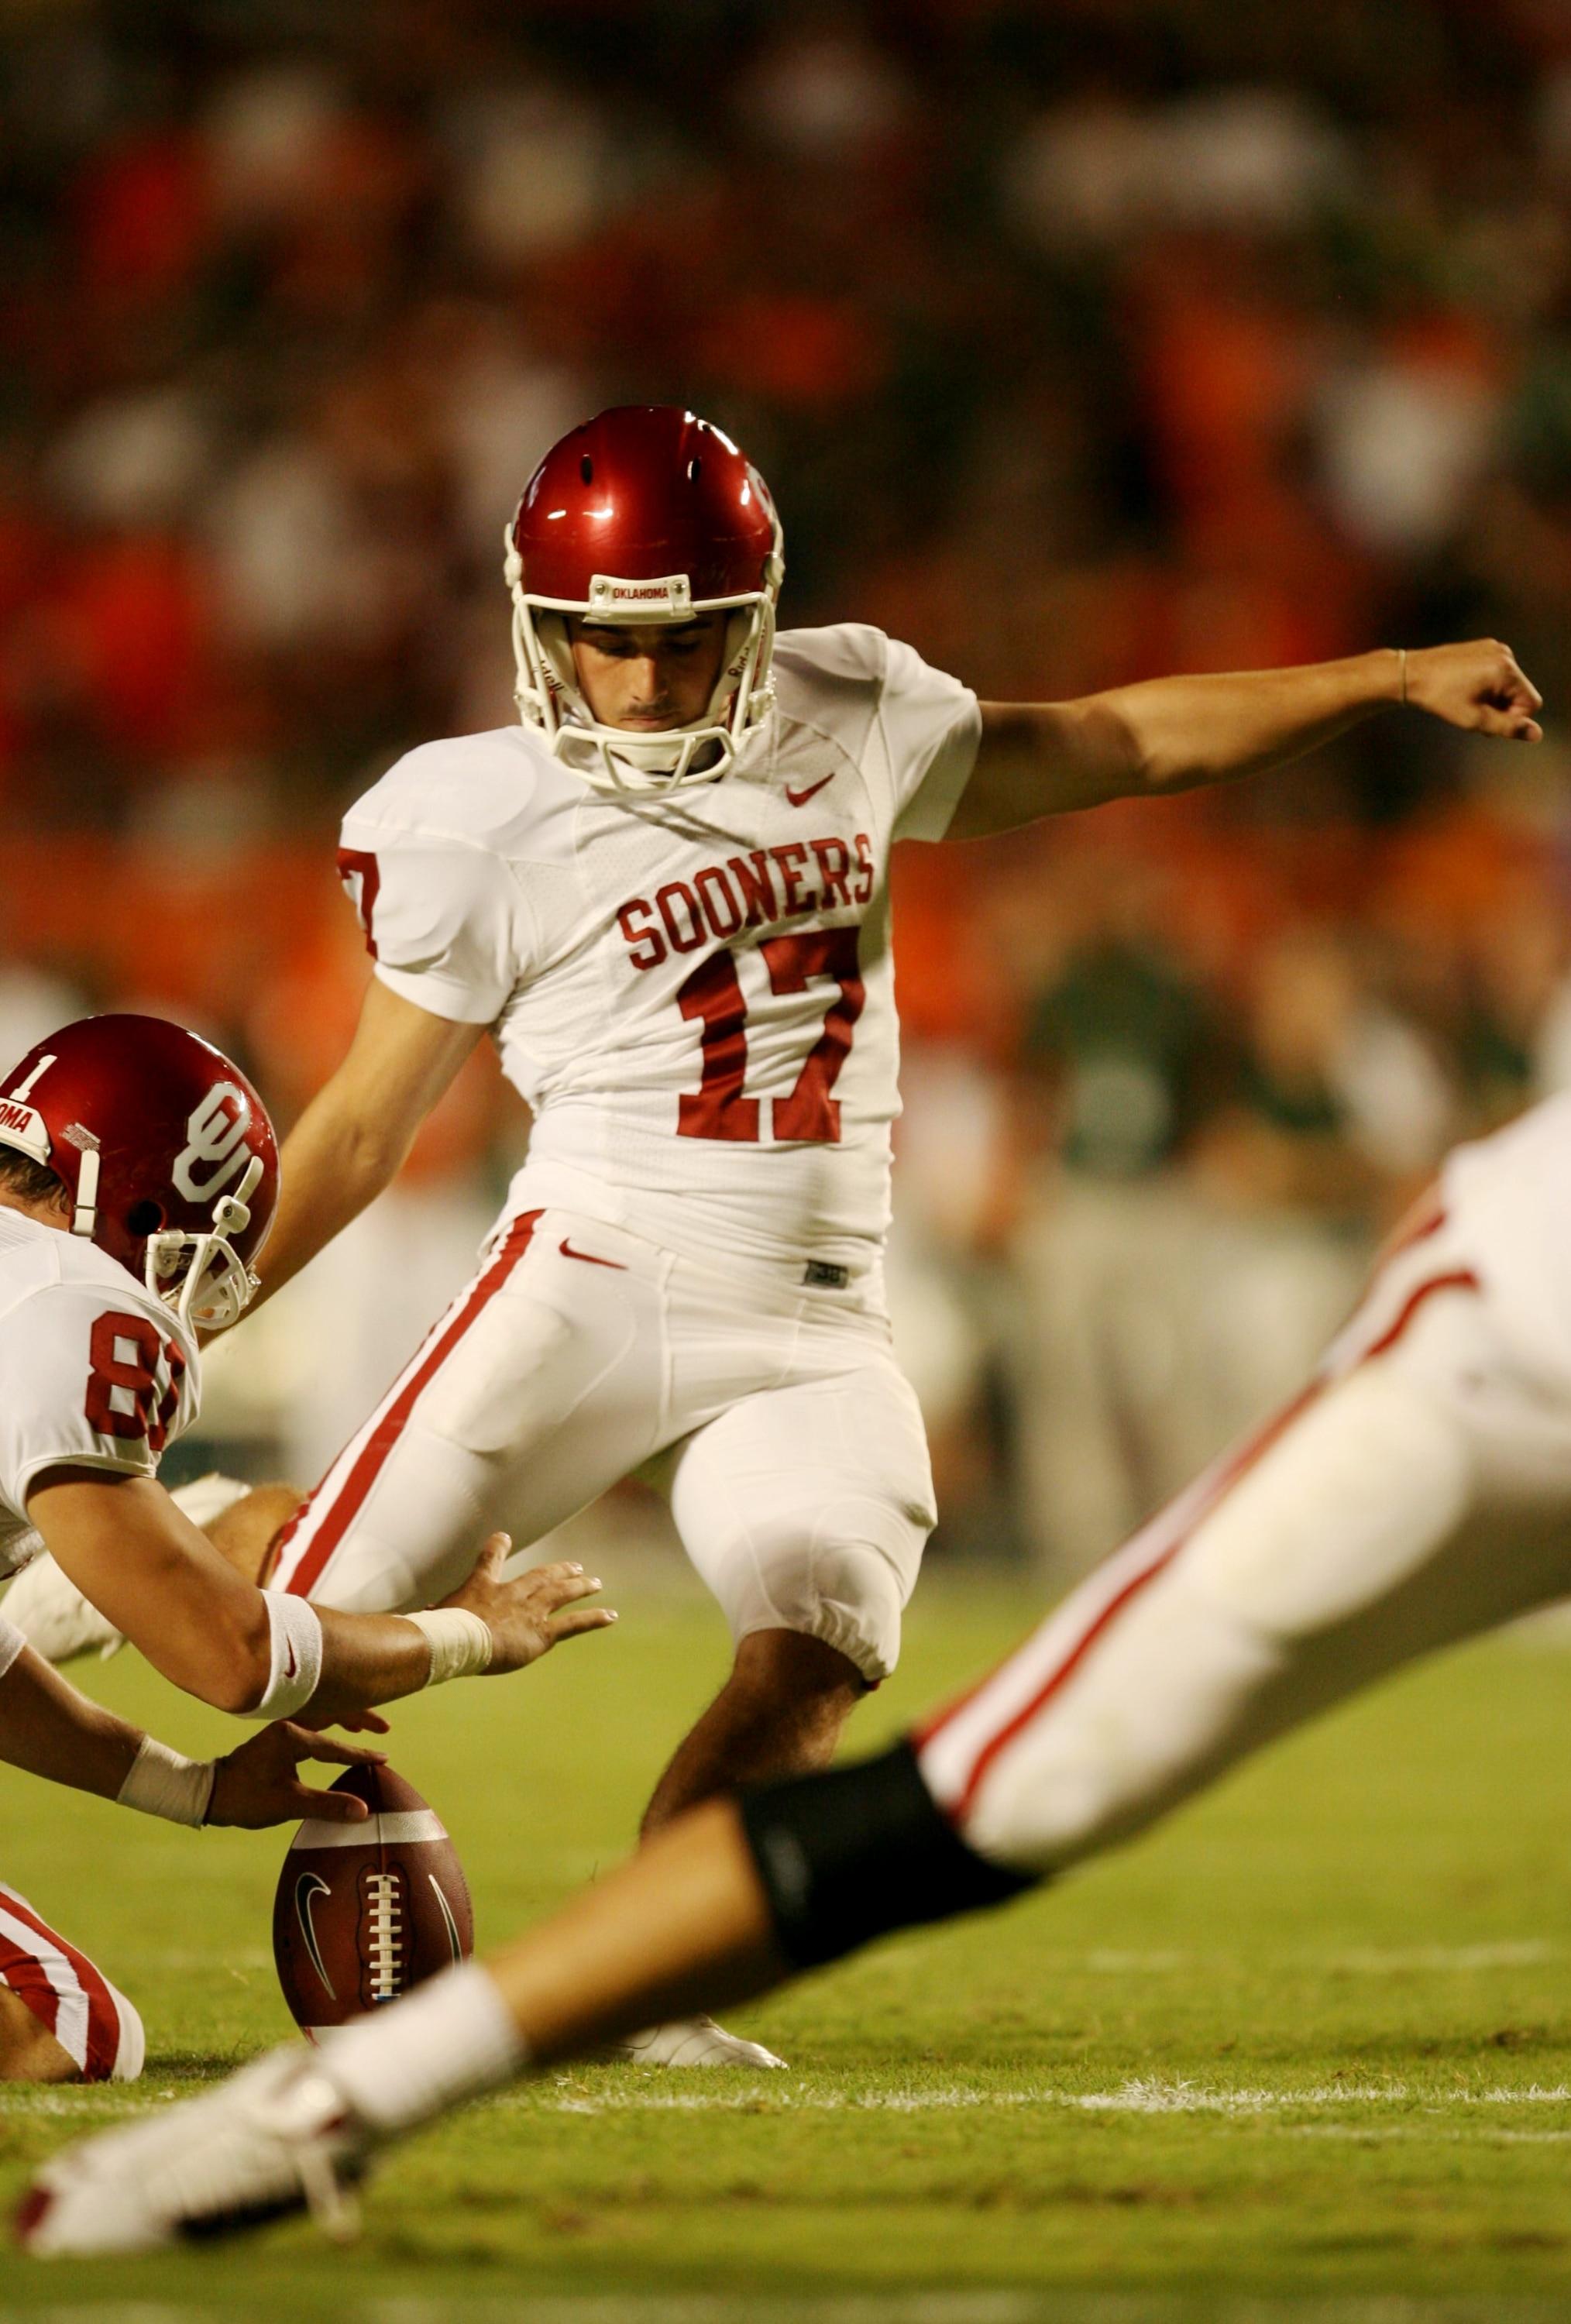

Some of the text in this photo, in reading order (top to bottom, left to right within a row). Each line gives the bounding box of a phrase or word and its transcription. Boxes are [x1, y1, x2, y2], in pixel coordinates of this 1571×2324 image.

[613, 587, 669, 599] OKLAHOMA
[617, 834, 874, 970] SOONERS
[9, 1054, 57, 1102] 1
[676, 926, 866, 1142] 17
